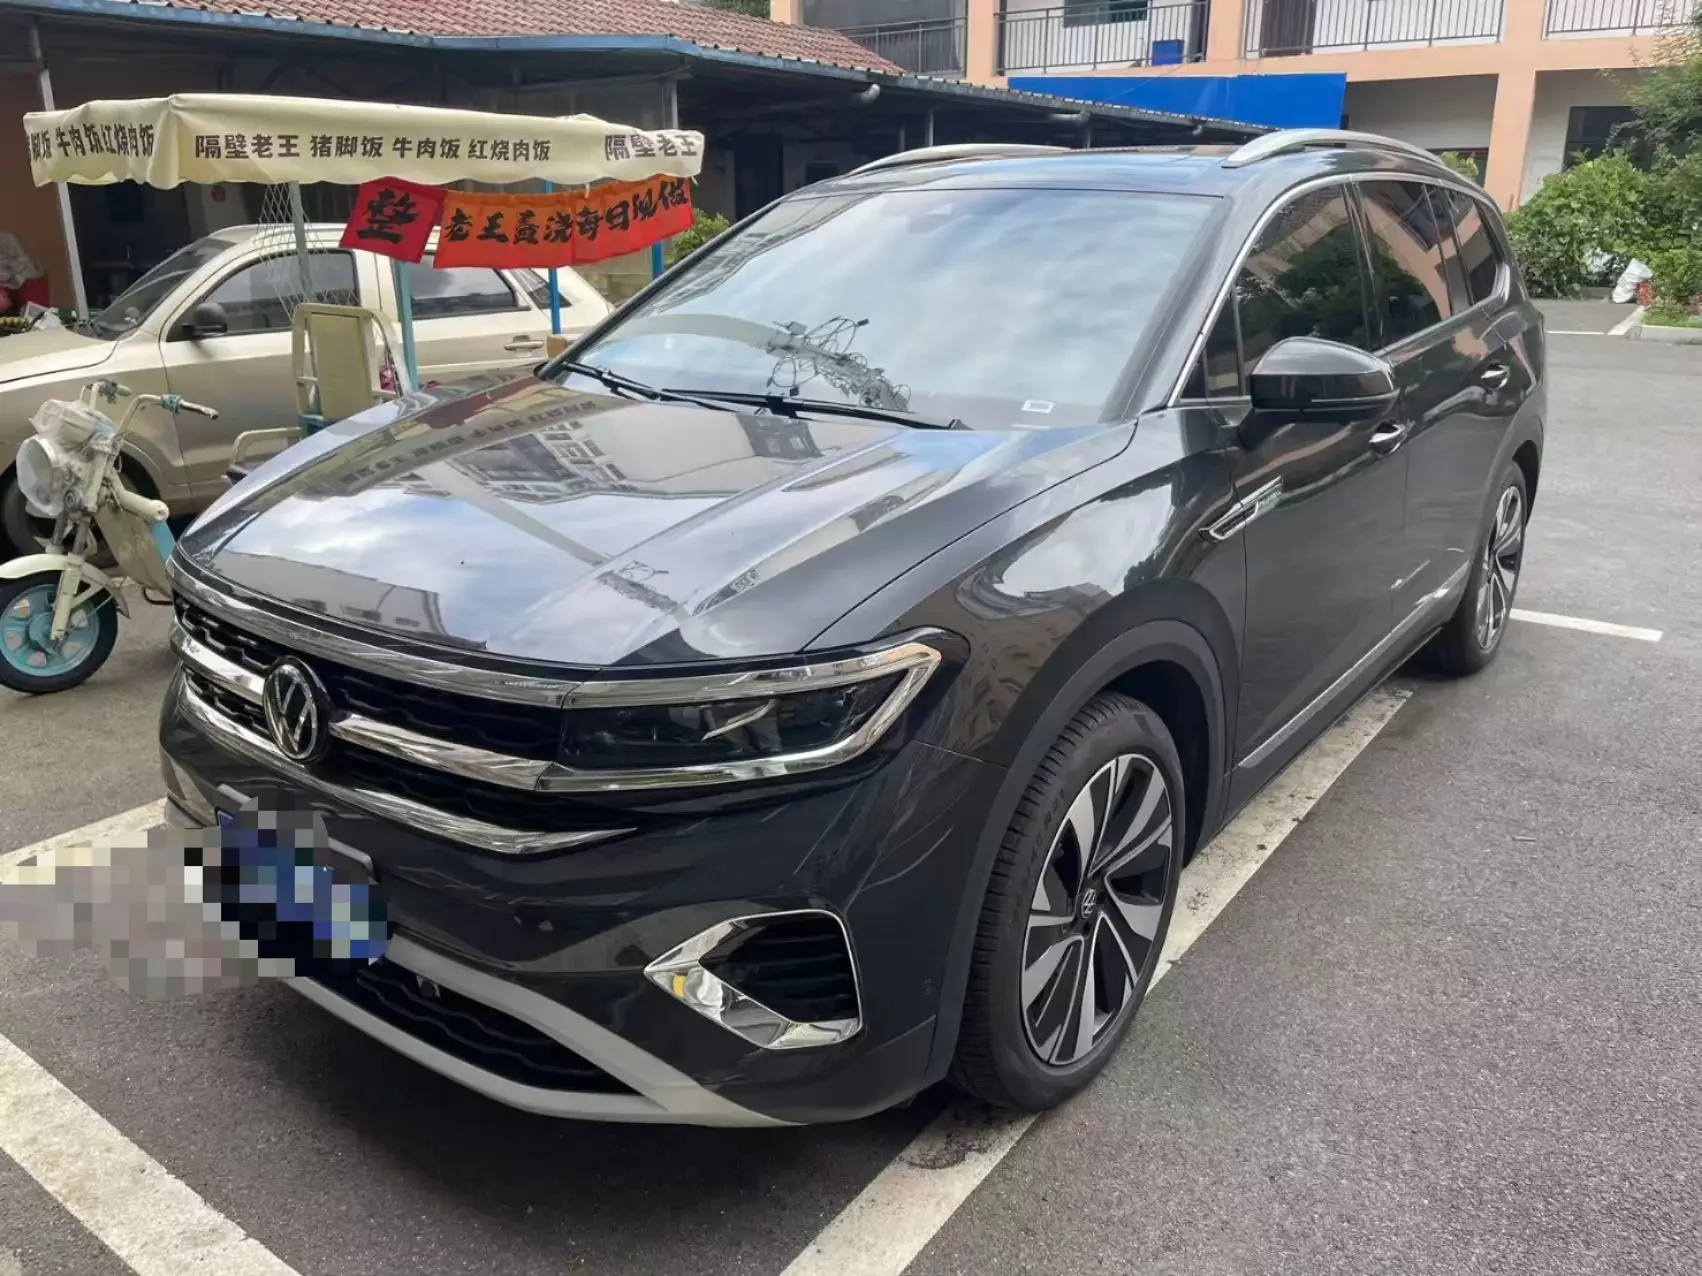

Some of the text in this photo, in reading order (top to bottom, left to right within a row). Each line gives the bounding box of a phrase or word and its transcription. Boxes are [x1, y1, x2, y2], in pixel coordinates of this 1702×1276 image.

[195, 133, 552, 162] 隔壁老王 猪脚饭 牛肉饭 红烧肉饭
[604, 133, 698, 162] 隔壁老王
